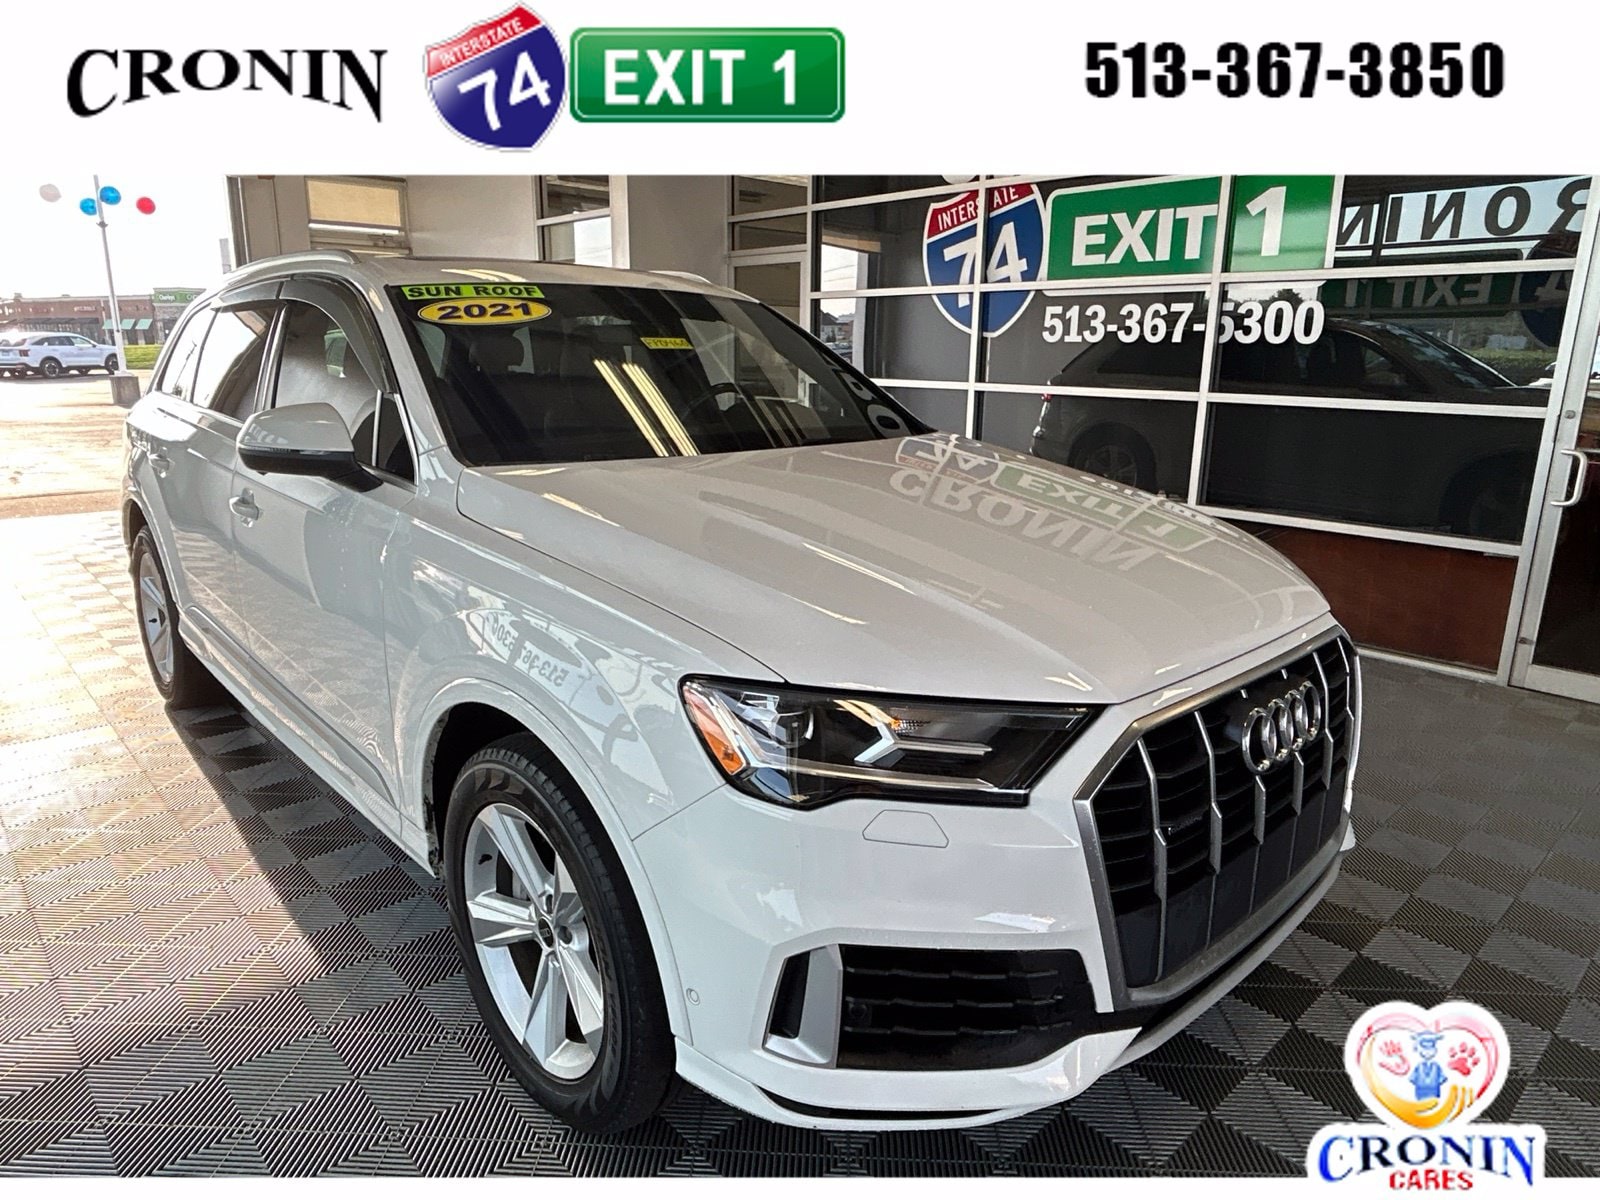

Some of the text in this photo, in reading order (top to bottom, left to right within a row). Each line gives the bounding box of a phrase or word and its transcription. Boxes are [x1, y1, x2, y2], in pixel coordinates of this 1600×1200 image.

[938, 186, 1019, 231] INTERATE
[1071, 185, 1287, 266] EXIT 1
[943, 221, 1028, 308] 74
[406, 285, 537, 299] SUN ROOF
[436, 302, 533, 320] 2021
[1041, 300, 1326, 344] 513-367-5300
